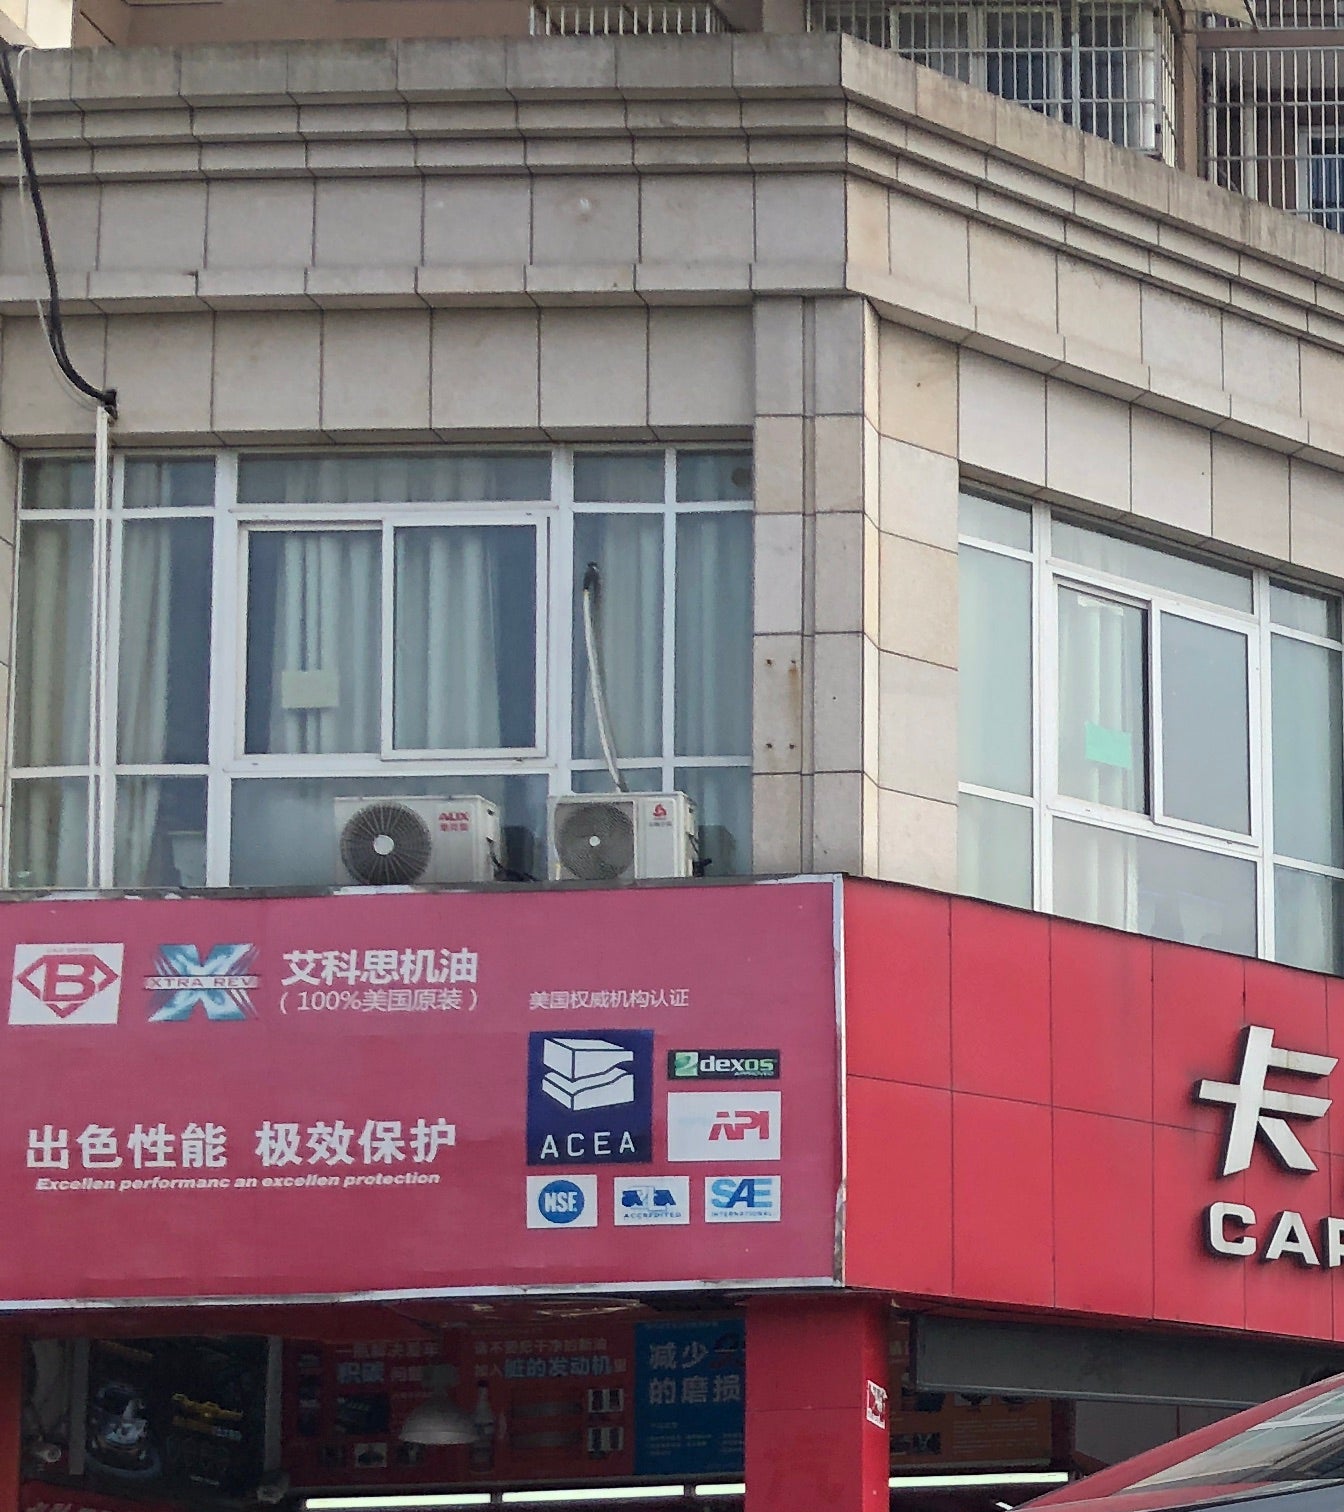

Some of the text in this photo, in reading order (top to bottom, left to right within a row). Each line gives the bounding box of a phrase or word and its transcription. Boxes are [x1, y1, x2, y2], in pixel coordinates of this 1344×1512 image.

[281, 947, 478, 986] 艾科思机油
[149, 977, 252, 988] XTRA REV
[529, 988, 690, 1010] 美国权威机构认证
[700, 1055, 774, 1072] dexos
[708, 1110, 770, 1141] API
[27, 1117, 456, 1170] 出色性能 极效保护
[540, 1131, 636, 1160] ACEA
[234, 1176, 258, 1188] an
[343, 1171, 441, 1189] protection
[711, 1178, 773, 1209] SAE
